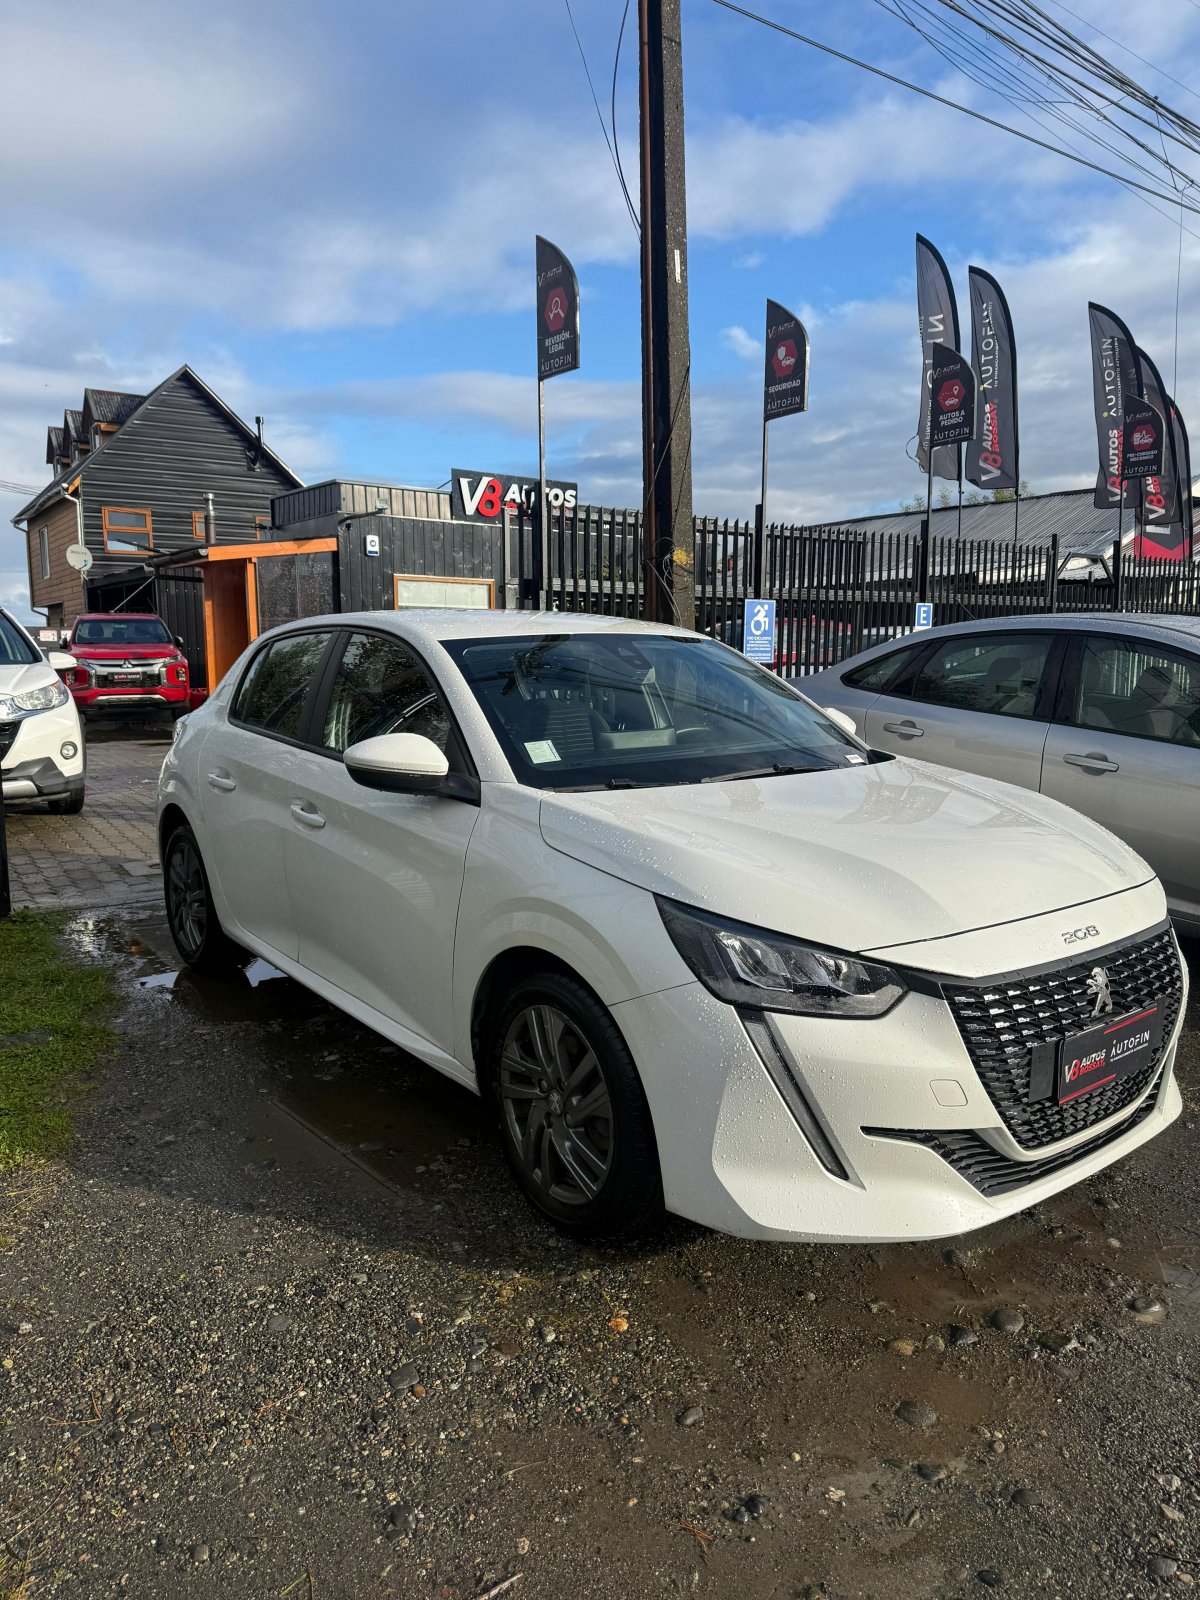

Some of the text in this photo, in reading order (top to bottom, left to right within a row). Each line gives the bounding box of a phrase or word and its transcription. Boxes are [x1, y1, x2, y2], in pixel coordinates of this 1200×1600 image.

[545, 330, 570, 348] REVISIÓN
[548, 342, 565, 354] LEGAL
[540, 353, 572, 372] AUTOFIN
[1102, 338, 1116, 416] AUTOFIN
[768, 380, 800, 394] SEGURIDAD
[767, 395, 800, 410] AUTOFIN
[939, 410, 960, 422] AUTOS
[940, 416, 964, 427] PEDIDO
[934, 426, 970, 440] AUTOFIN
[990, 402, 1000, 452] BOSSAY
[979, 404, 1002, 481] V8 AUTOS
[1108, 429, 1118, 475] AUTOS
[1124, 465, 1158, 474] AUTOFIN
[459, 476, 502, 517] V8
[504, 484, 576, 508] AUOS
[1146, 495, 1166, 520] V8
[920, 607, 927, 623] E
[1062, 925, 1100, 944] 208
[1110, 1030, 1150, 1057] AUTOFIN
[1065, 1060, 1080, 1083] V8
[1080, 1049, 1106, 1067] AUTOS
[1080, 1059, 1105, 1076] BOSSAY
